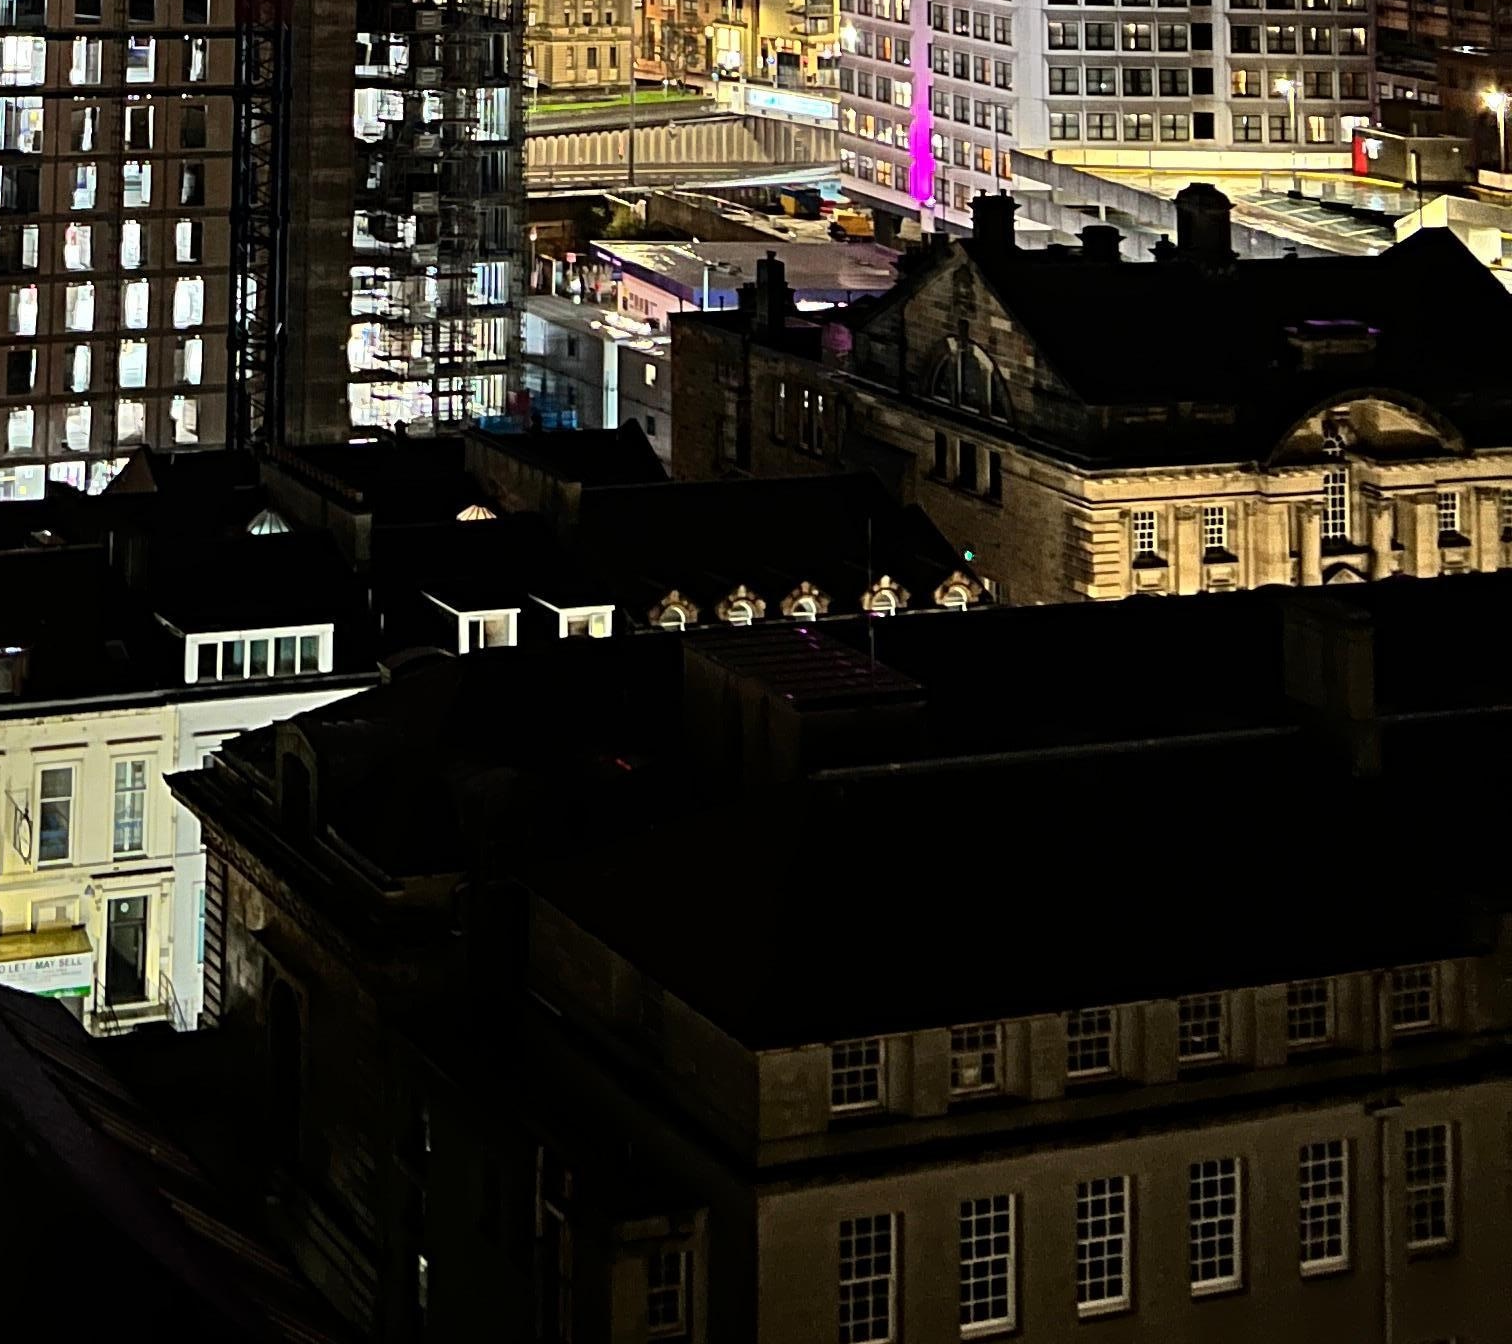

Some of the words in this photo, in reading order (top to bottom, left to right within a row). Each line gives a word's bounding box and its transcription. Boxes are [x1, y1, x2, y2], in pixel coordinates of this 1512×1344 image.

[9, 963, 26, 973] LET
[35, 959, 55, 970] MAY
[59, 957, 82, 968] SELL
